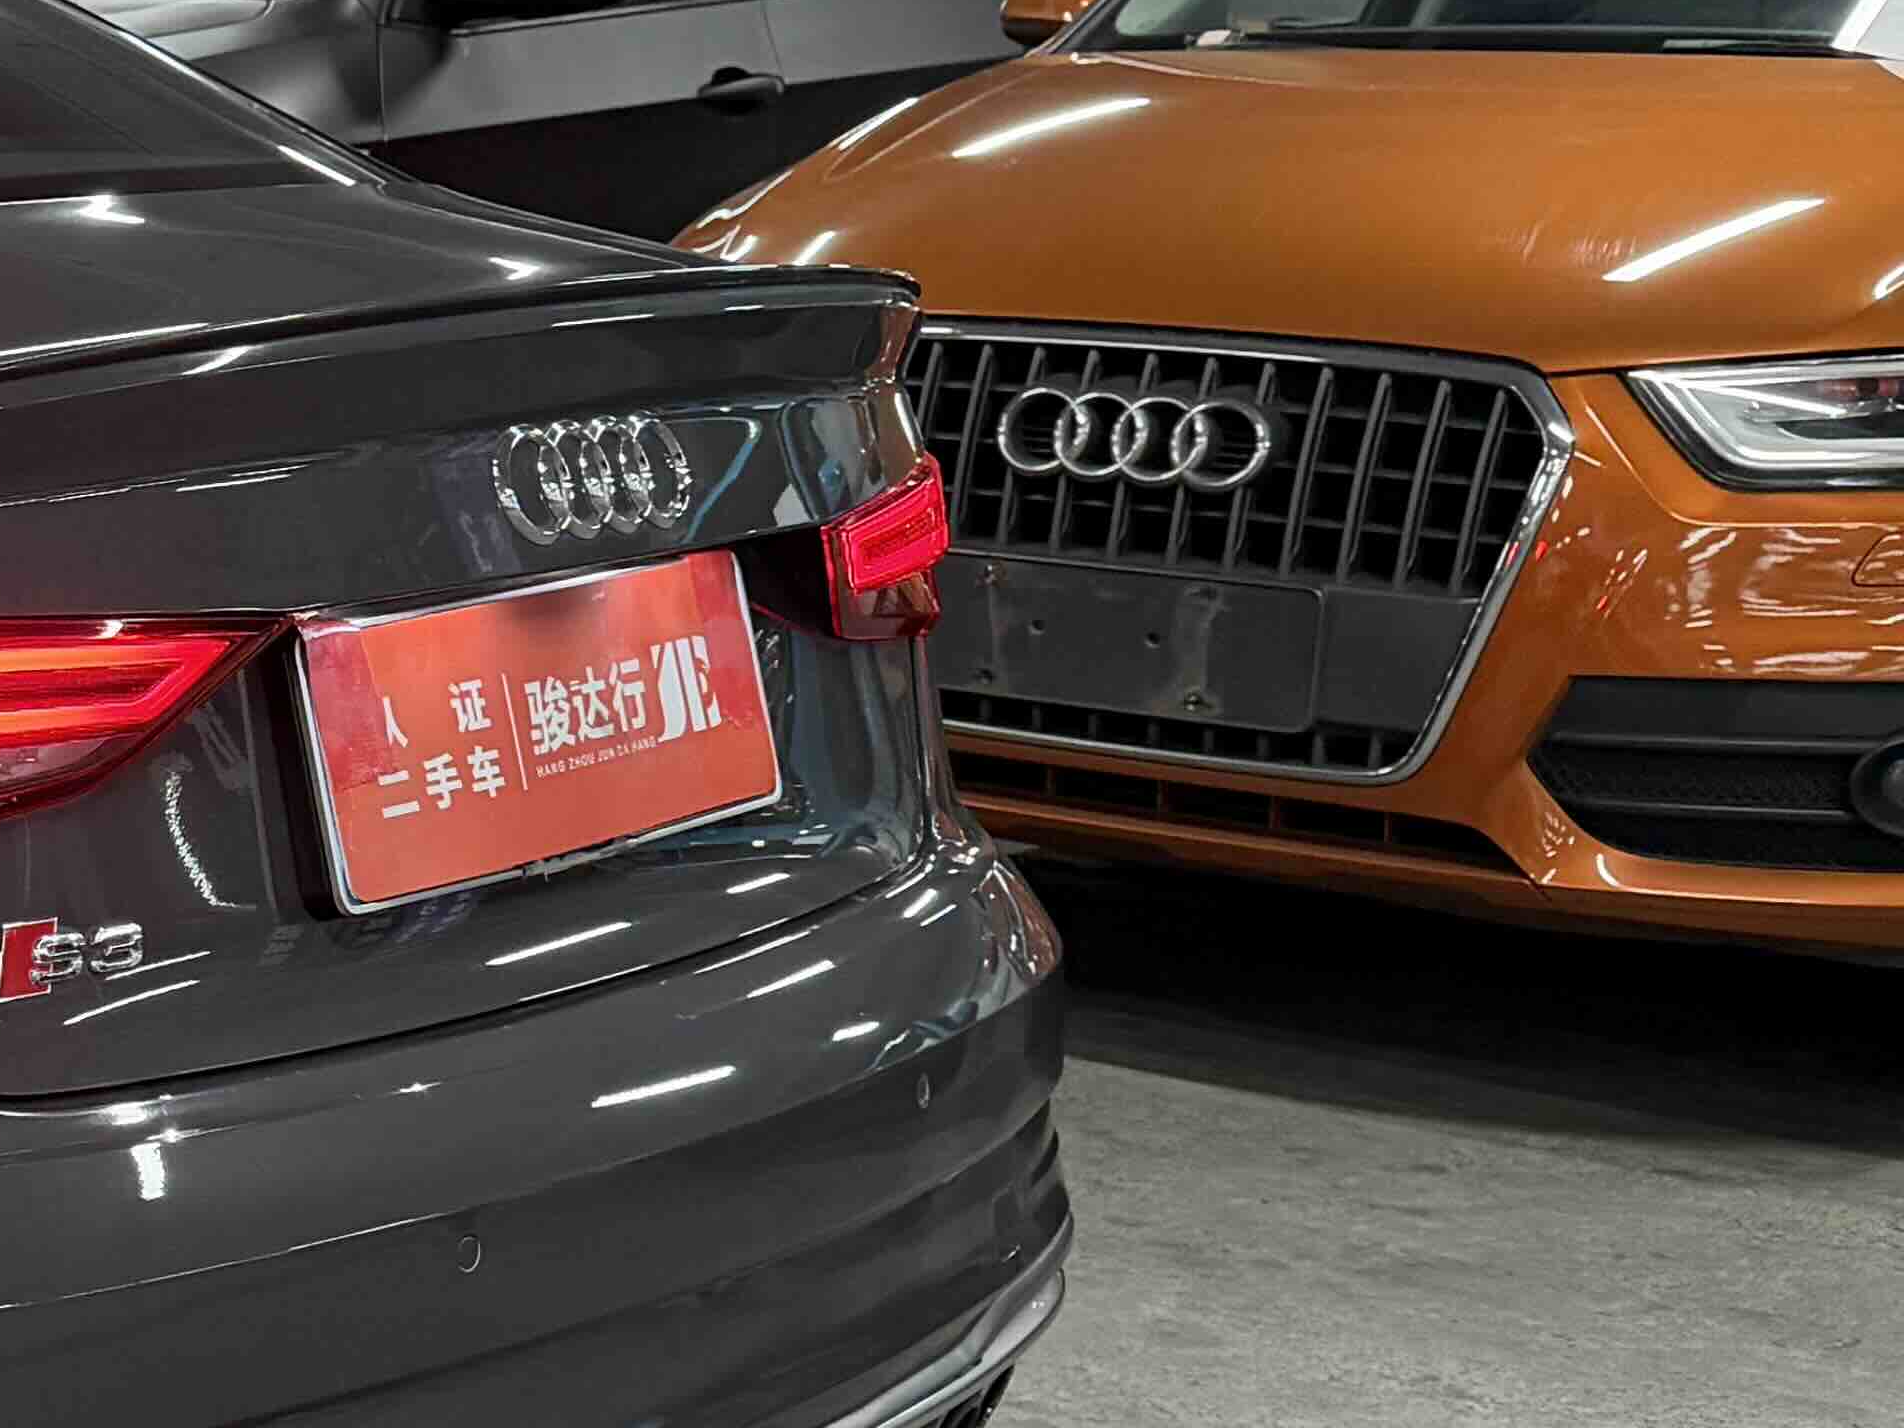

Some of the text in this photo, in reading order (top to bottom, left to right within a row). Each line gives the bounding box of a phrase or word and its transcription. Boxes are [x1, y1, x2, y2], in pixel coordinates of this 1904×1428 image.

[524, 657, 647, 756] 骏达行
[377, 745, 506, 819] 二手车
[29, 922, 144, 985] S3
